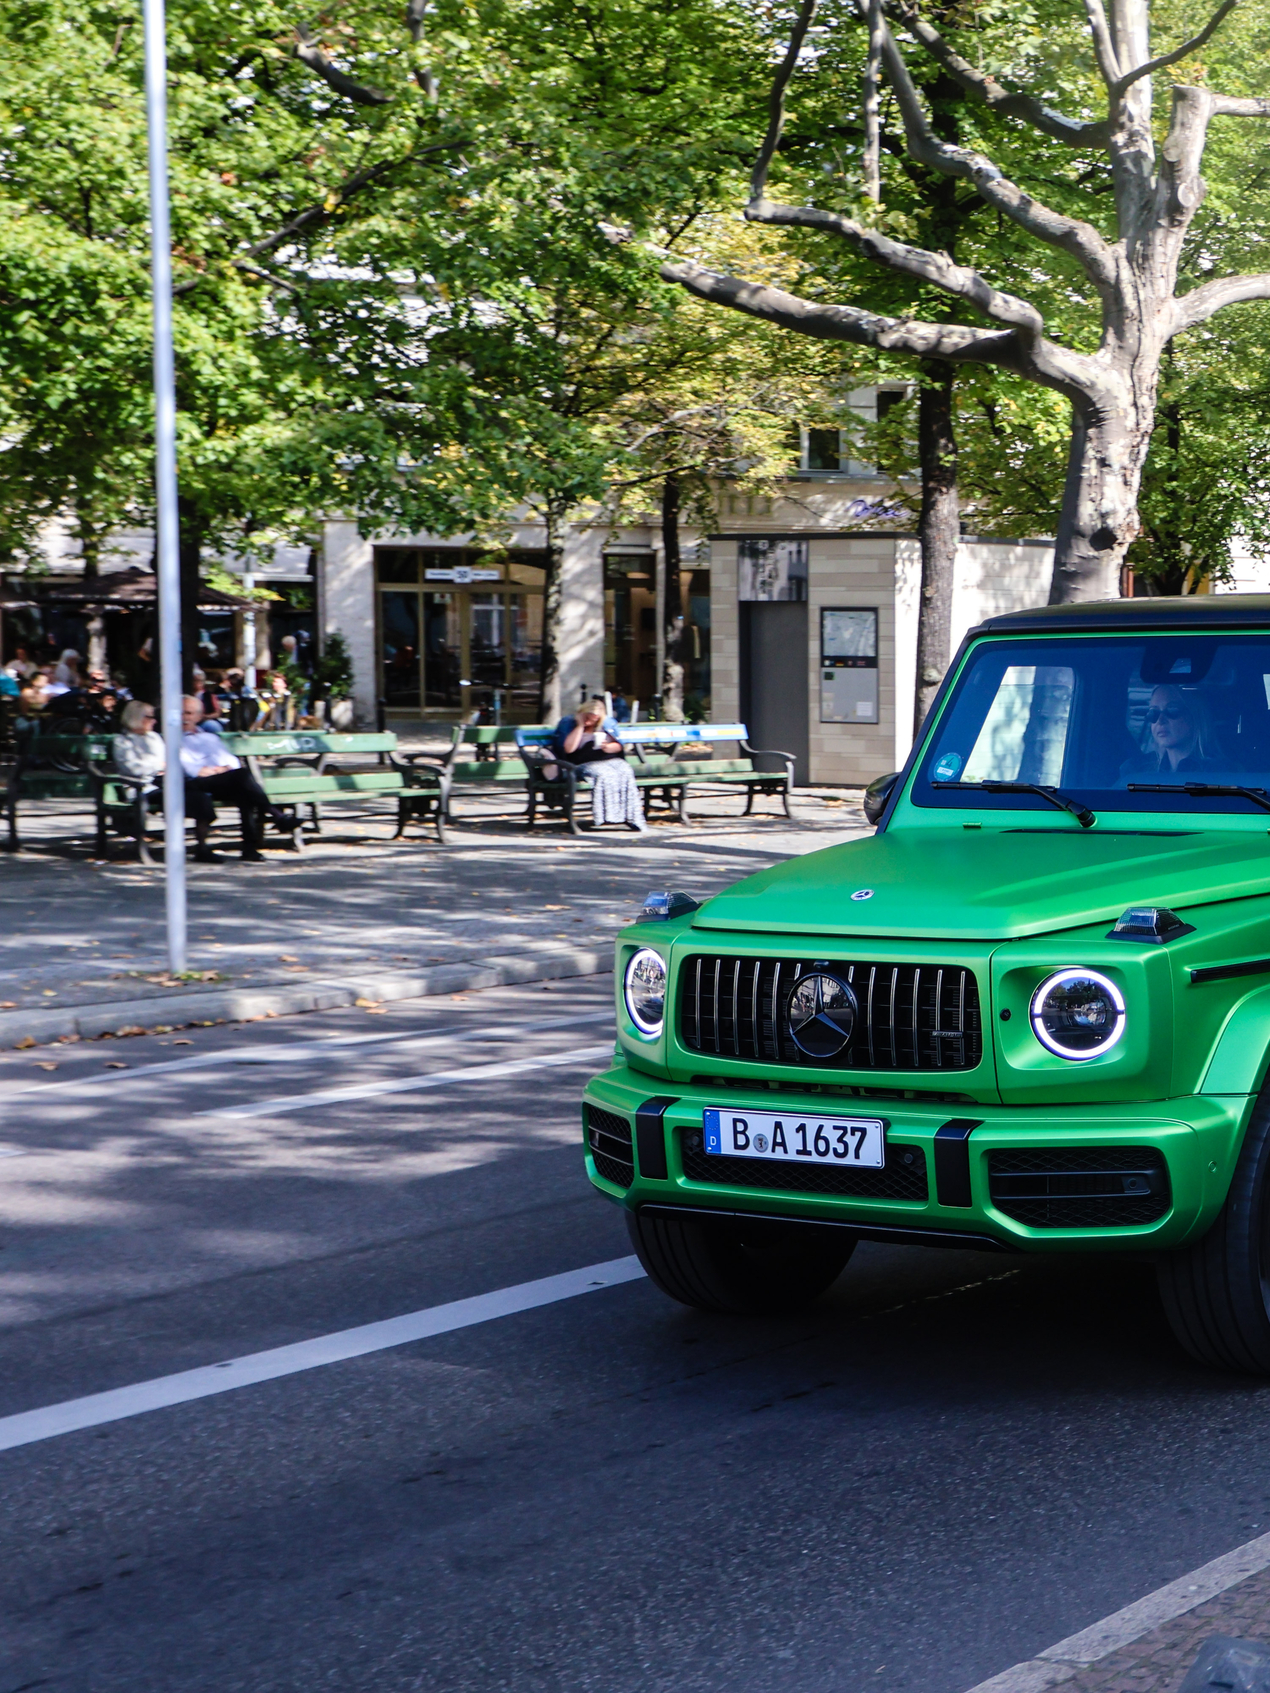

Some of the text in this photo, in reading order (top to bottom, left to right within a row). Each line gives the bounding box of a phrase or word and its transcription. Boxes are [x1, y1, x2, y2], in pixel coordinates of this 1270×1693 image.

[709, 1135, 717, 1146] D
[732, 1117, 868, 1160] B A 1637
